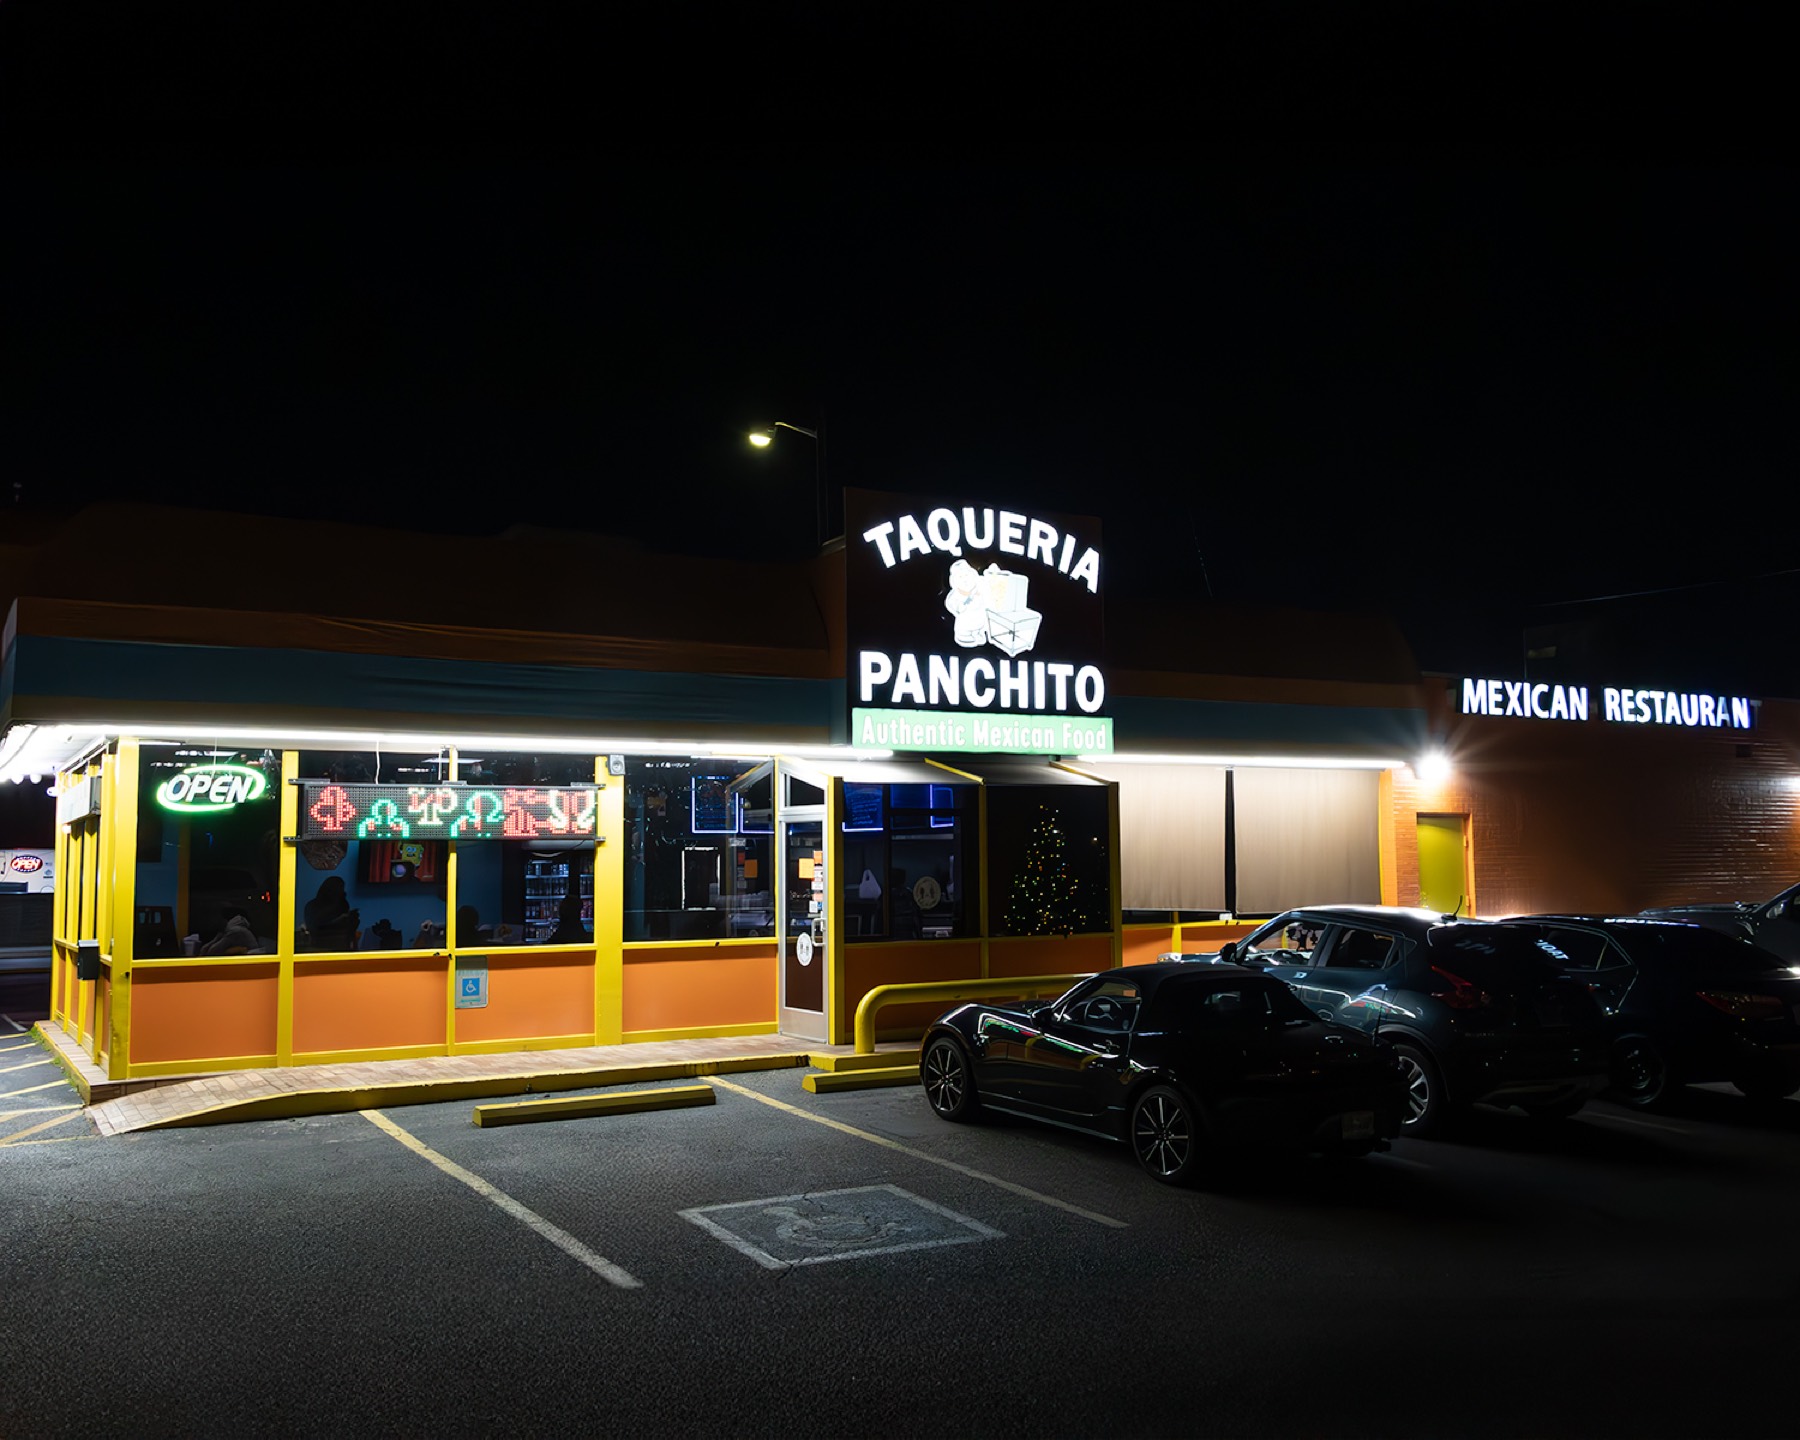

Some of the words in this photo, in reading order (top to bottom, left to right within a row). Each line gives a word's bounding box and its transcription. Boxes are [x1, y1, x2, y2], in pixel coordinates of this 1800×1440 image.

[863, 507, 1100, 593] TAQUERIA
[860, 651, 1105, 713] PANCHITO
[1463, 678, 1588, 721] MEXICAN
[861, 715, 966, 745] Authentic
[973, 719, 1054, 749] Mexican
[1063, 722, 1106, 749] Food
[165, 774, 254, 803] OPEN
[11, 857, 41, 870] OPEN
